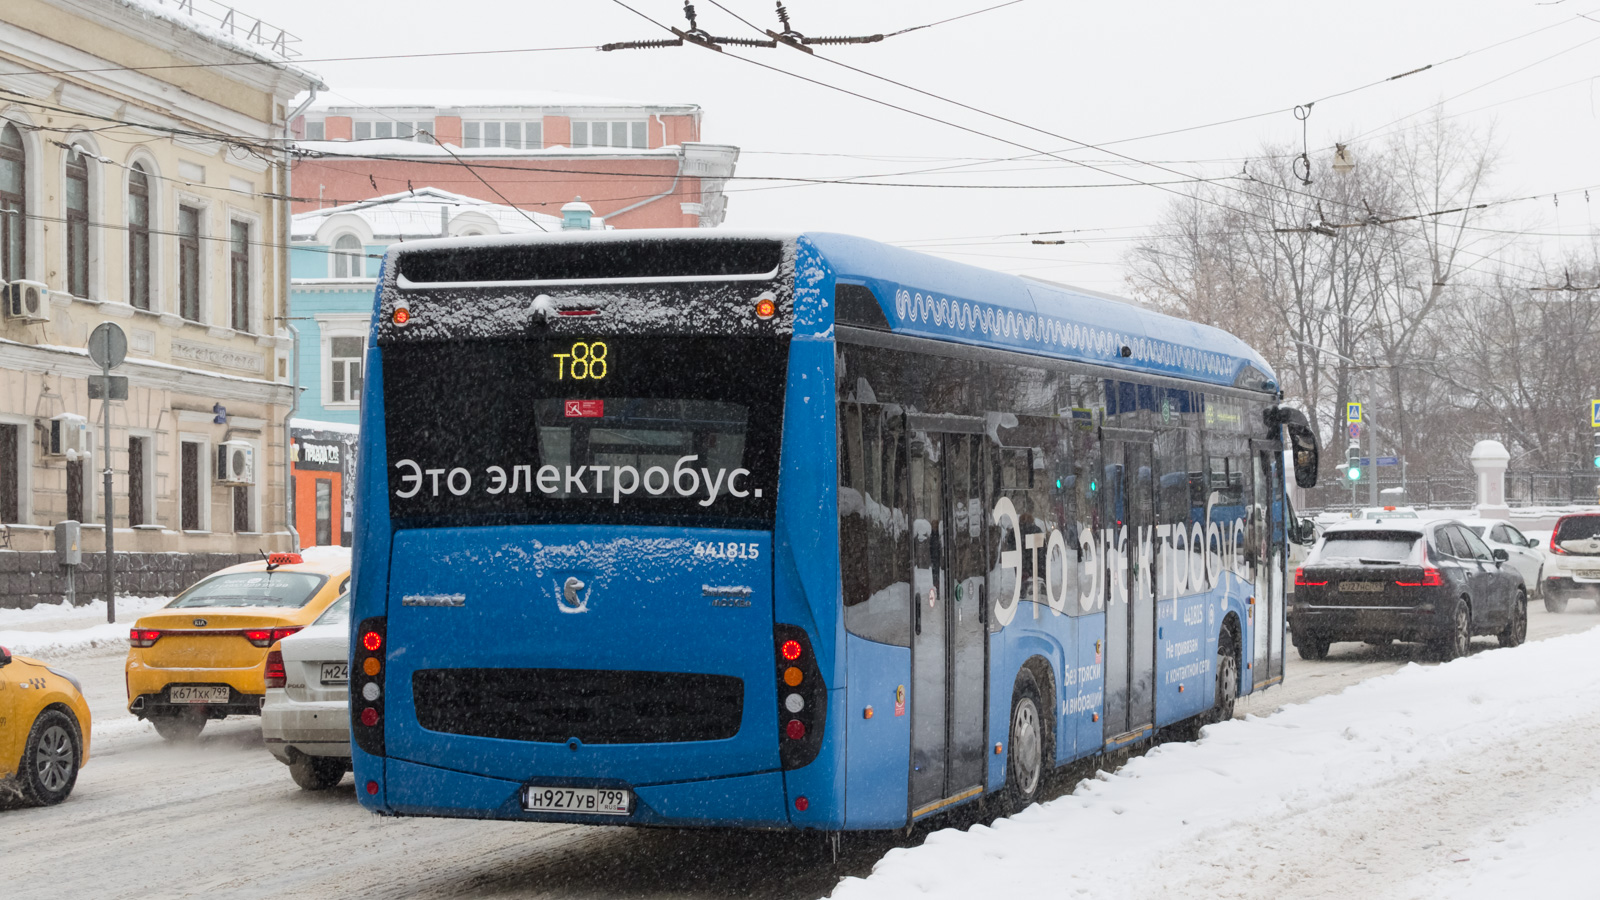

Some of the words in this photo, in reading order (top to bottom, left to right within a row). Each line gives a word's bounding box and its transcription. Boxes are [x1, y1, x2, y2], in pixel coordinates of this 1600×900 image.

[395, 459, 472, 499] Это
[486, 454, 763, 507] электробус.
[693, 541, 760, 559] 441815
[993, 496, 1068, 627] Это
[1064, 664, 1077, 687] Без
[1078, 663, 1101, 688] тряски
[173, 688, 210, 699] К671ХК
[212, 687, 227, 696] 799
[533, 790, 596, 809] Н927УВ
[599, 791, 623, 805] 799
